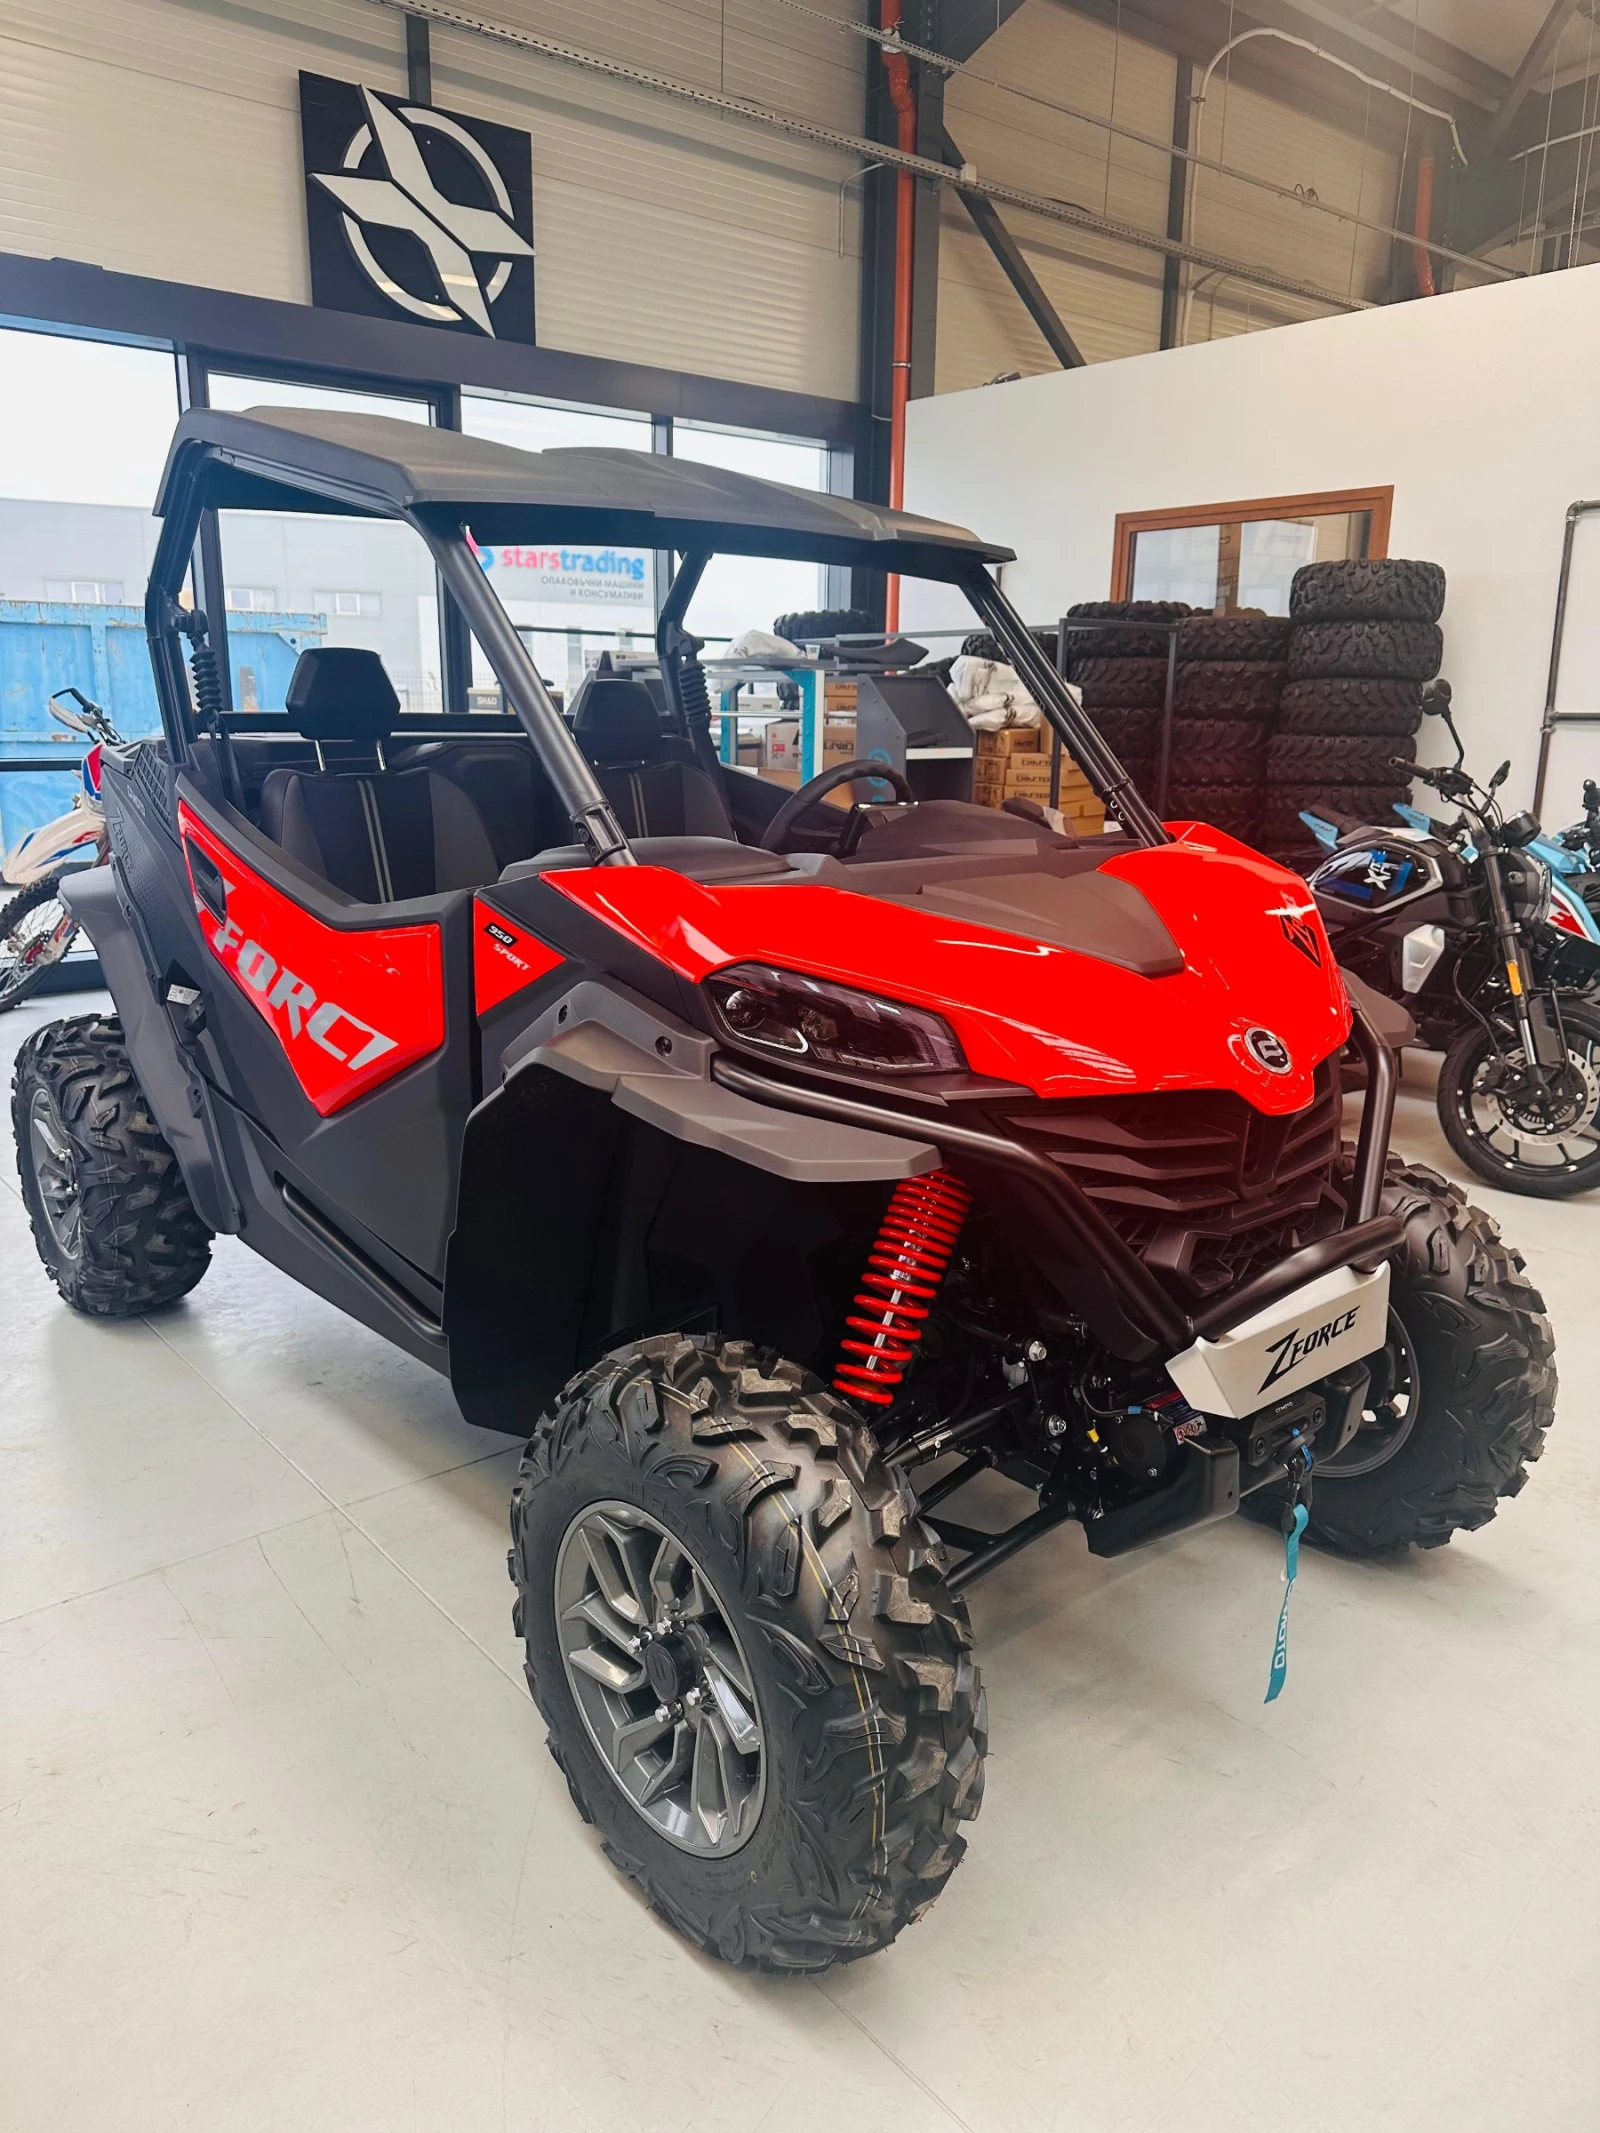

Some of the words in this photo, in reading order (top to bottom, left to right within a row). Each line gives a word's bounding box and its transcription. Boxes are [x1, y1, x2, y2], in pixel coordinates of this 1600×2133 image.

[502, 547, 645, 581] starstrading
[541, 575, 602, 588] ОПАКОВЪЧНИ
[570, 588, 577, 597] И
[488, 925, 514, 945] 950
[493, 943, 532, 971] SPORT
